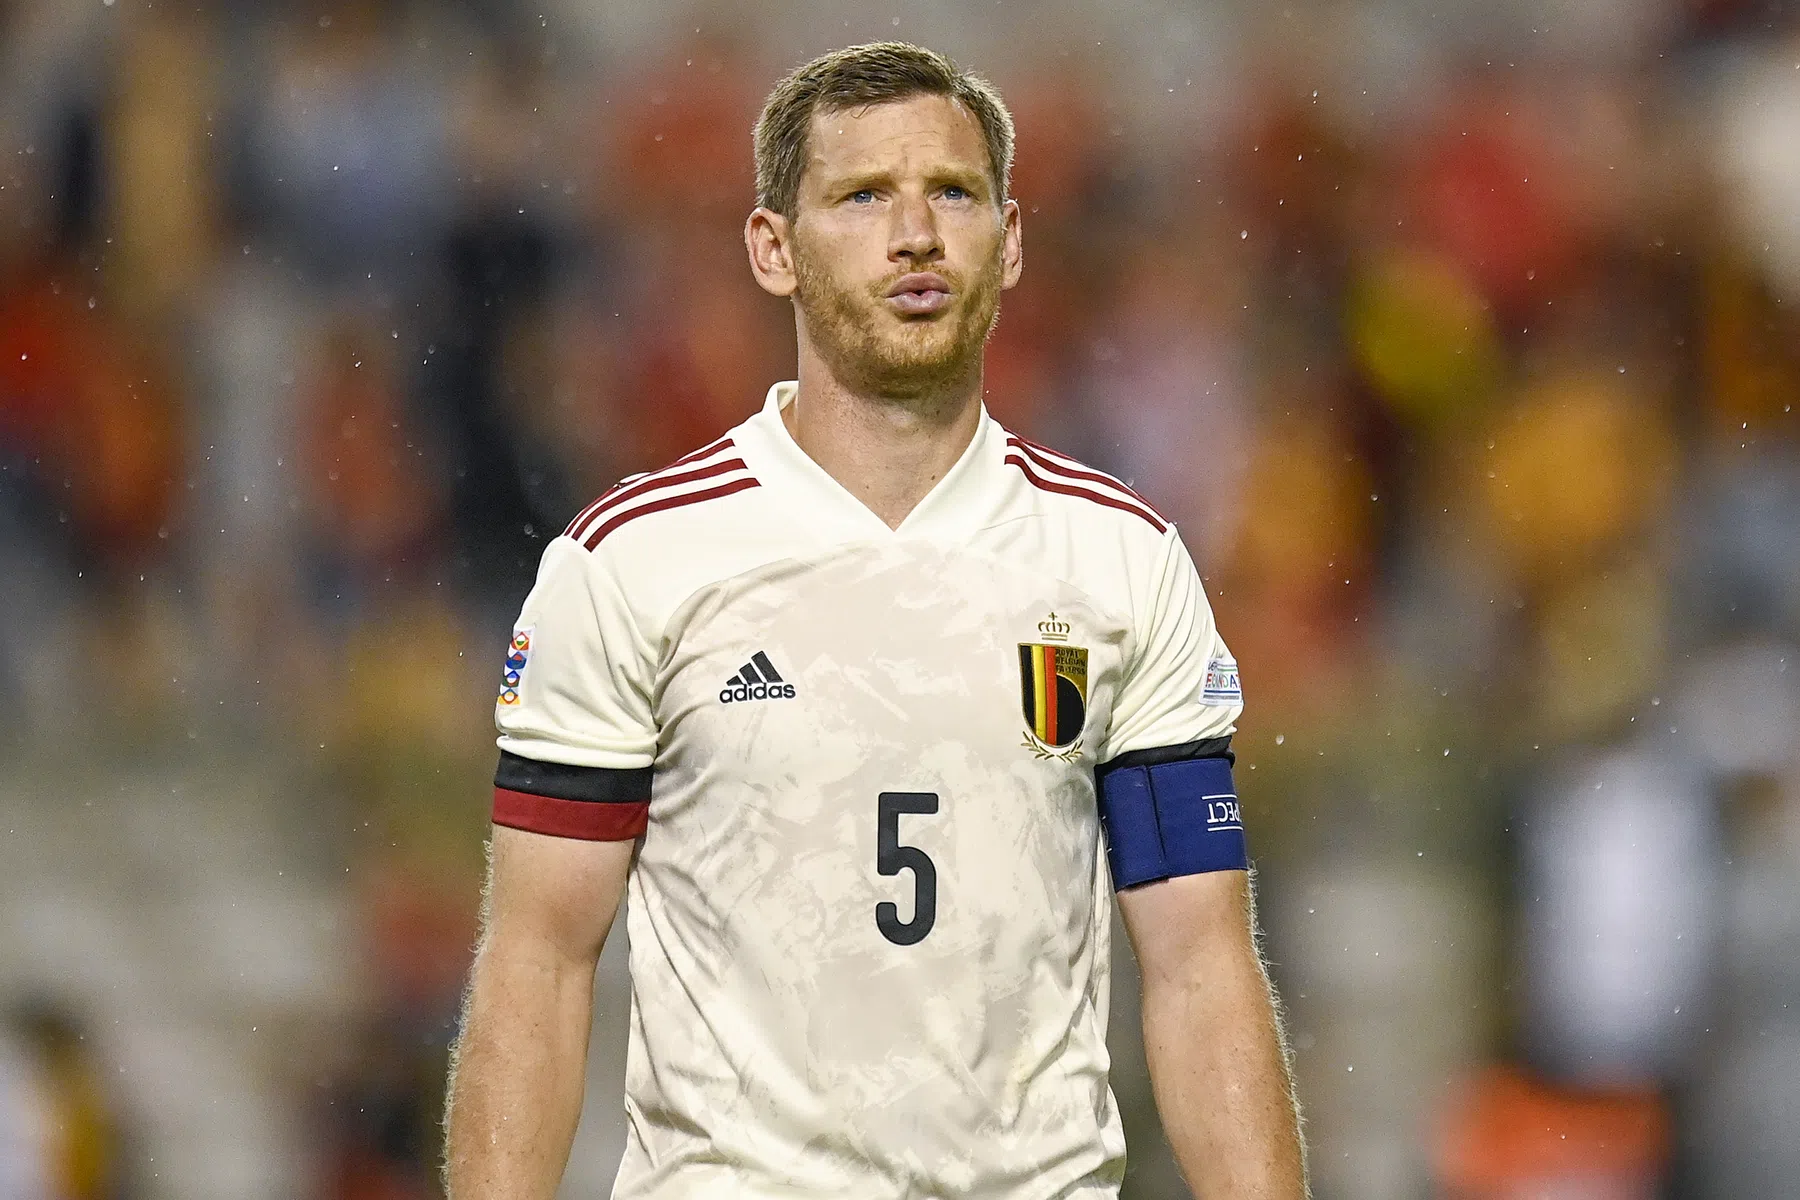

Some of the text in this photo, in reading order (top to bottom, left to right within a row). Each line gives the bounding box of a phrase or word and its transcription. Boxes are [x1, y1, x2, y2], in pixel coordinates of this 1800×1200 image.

[1056, 649, 1079, 659] ROYAL
[719, 683, 796, 703] adidas
[1207, 801, 1242, 823] PECT
[876, 792, 938, 945] 5
